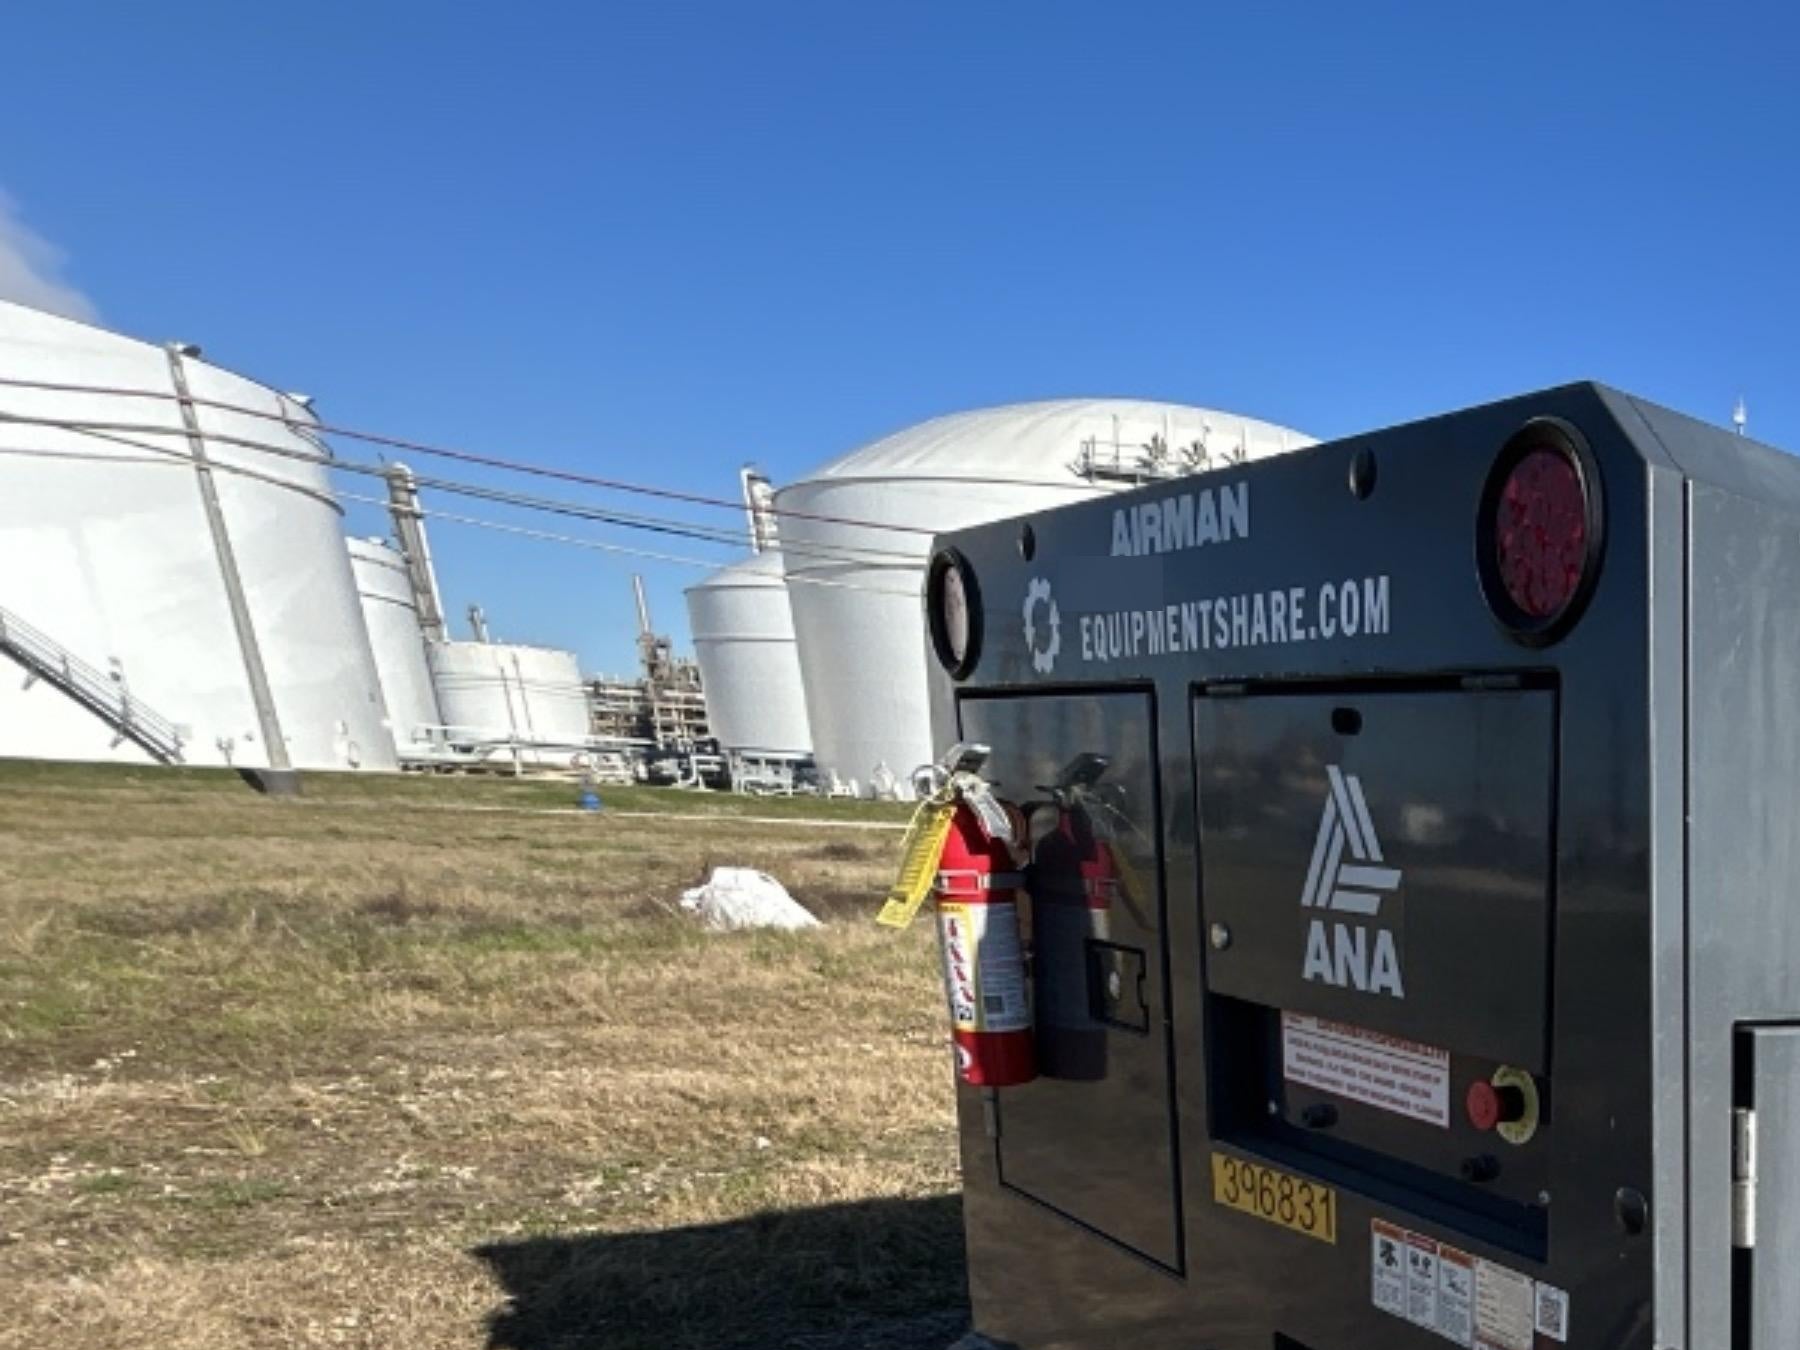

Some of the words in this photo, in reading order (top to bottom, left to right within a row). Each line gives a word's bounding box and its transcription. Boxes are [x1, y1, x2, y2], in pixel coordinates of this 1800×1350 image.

[1110, 481, 1250, 557] AIRMAN
[1080, 575, 1390, 662] EQUIPMENTSHARE.COM
[1302, 920, 1403, 997] ANA
[1222, 1157, 1335, 1240] 396831
